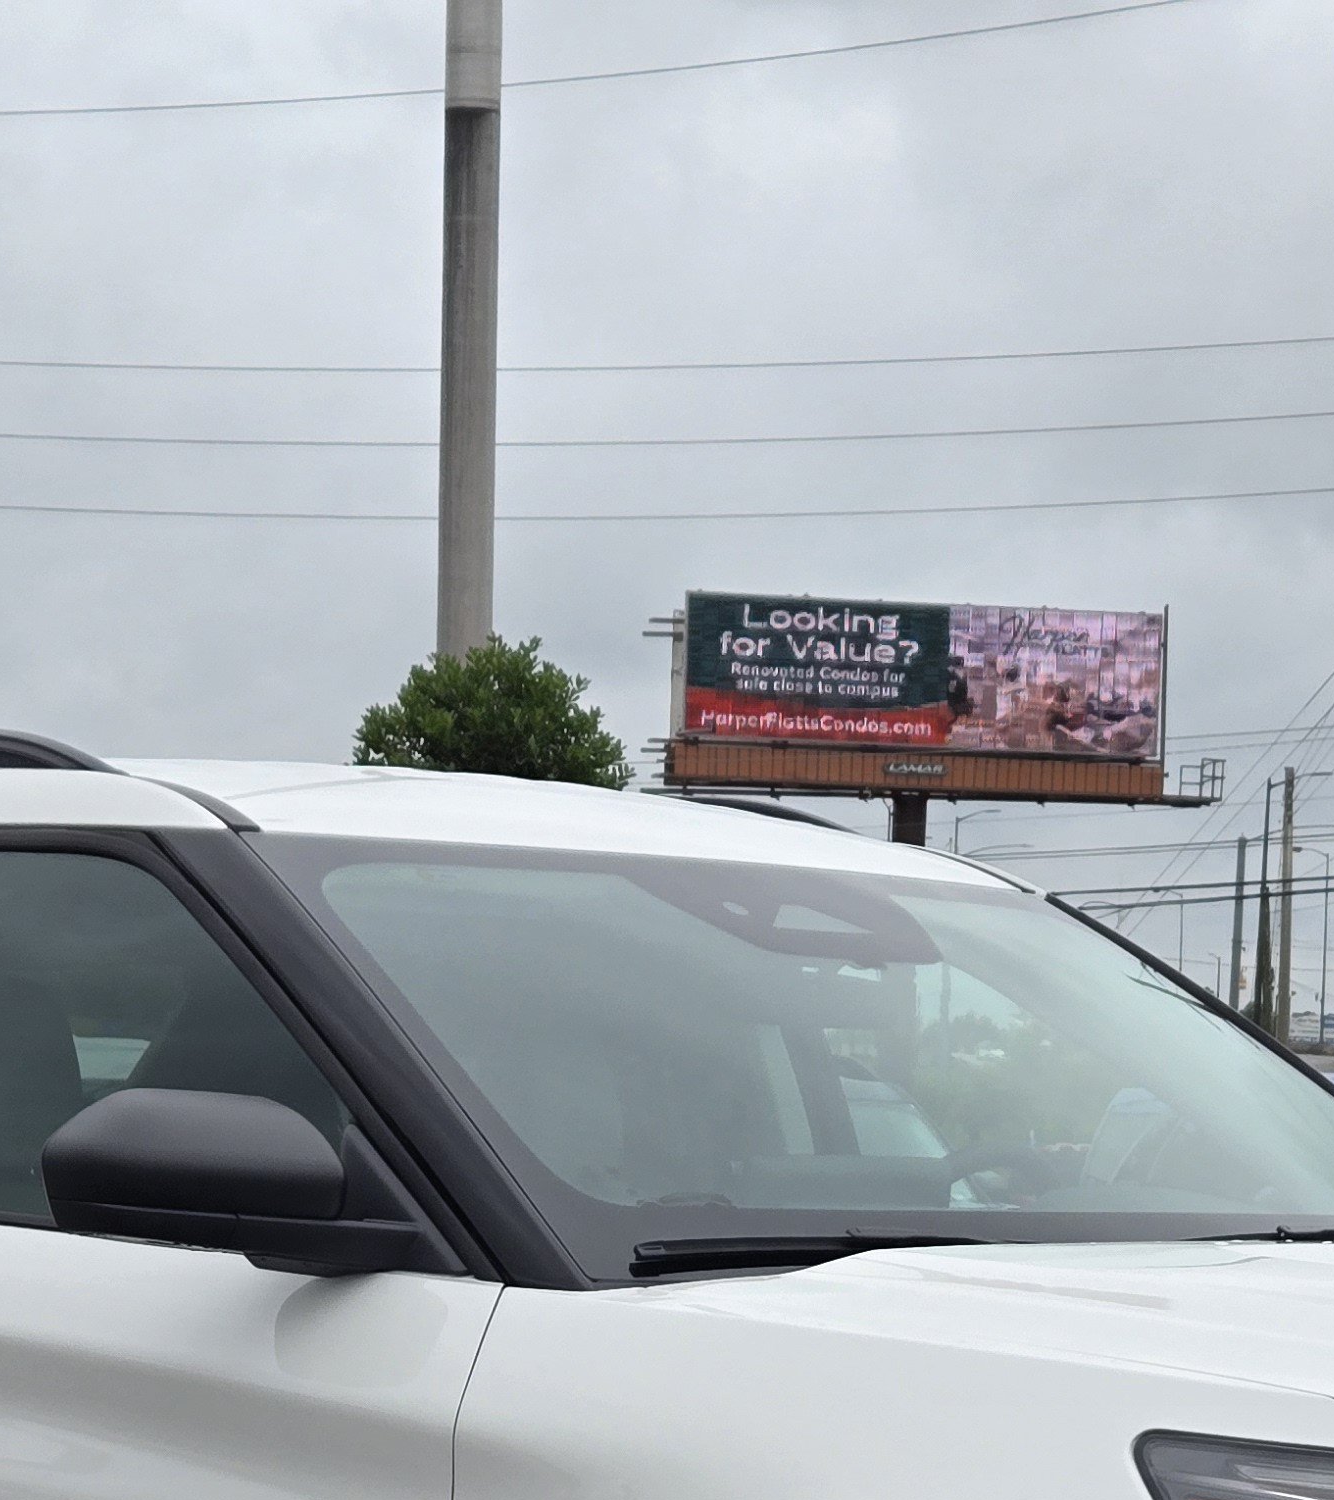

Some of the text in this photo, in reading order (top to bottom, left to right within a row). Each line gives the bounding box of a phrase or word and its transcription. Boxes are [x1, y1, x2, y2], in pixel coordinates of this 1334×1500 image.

[742, 603, 901, 641] Looking
[720, 630, 919, 666] for Value?
[731, 661, 906, 684] Renovated Condos for
[773, 679, 813, 694] close
[818, 681, 833, 696] to
[838, 683, 899, 700] campus
[889, 763, 944, 774] LAMAR
